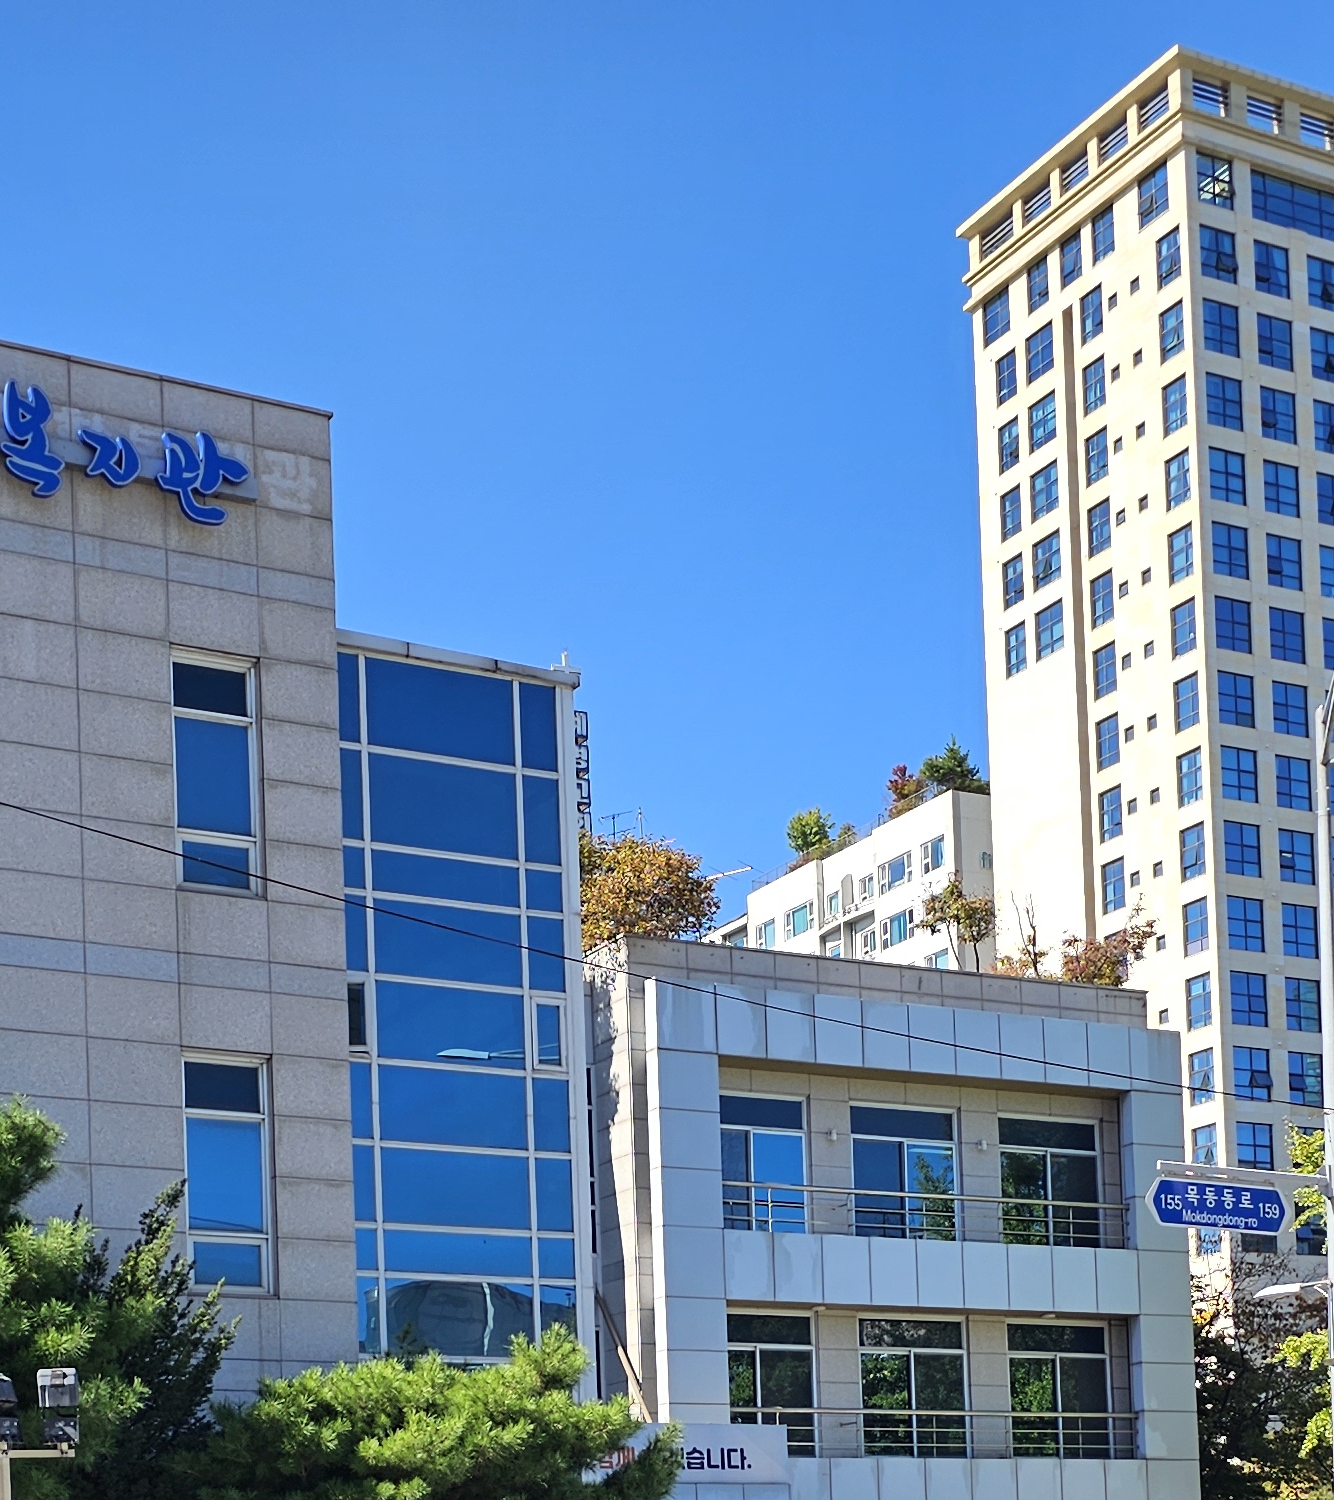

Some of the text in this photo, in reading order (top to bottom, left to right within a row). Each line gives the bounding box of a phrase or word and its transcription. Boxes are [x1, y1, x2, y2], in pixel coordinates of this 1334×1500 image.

[1159, 1185, 1280, 1219] 155 목동동로 159
[1182, 1208, 1258, 1228] Mokdongdong-ro
[679, 1447, 751, 1470] 습니다.
